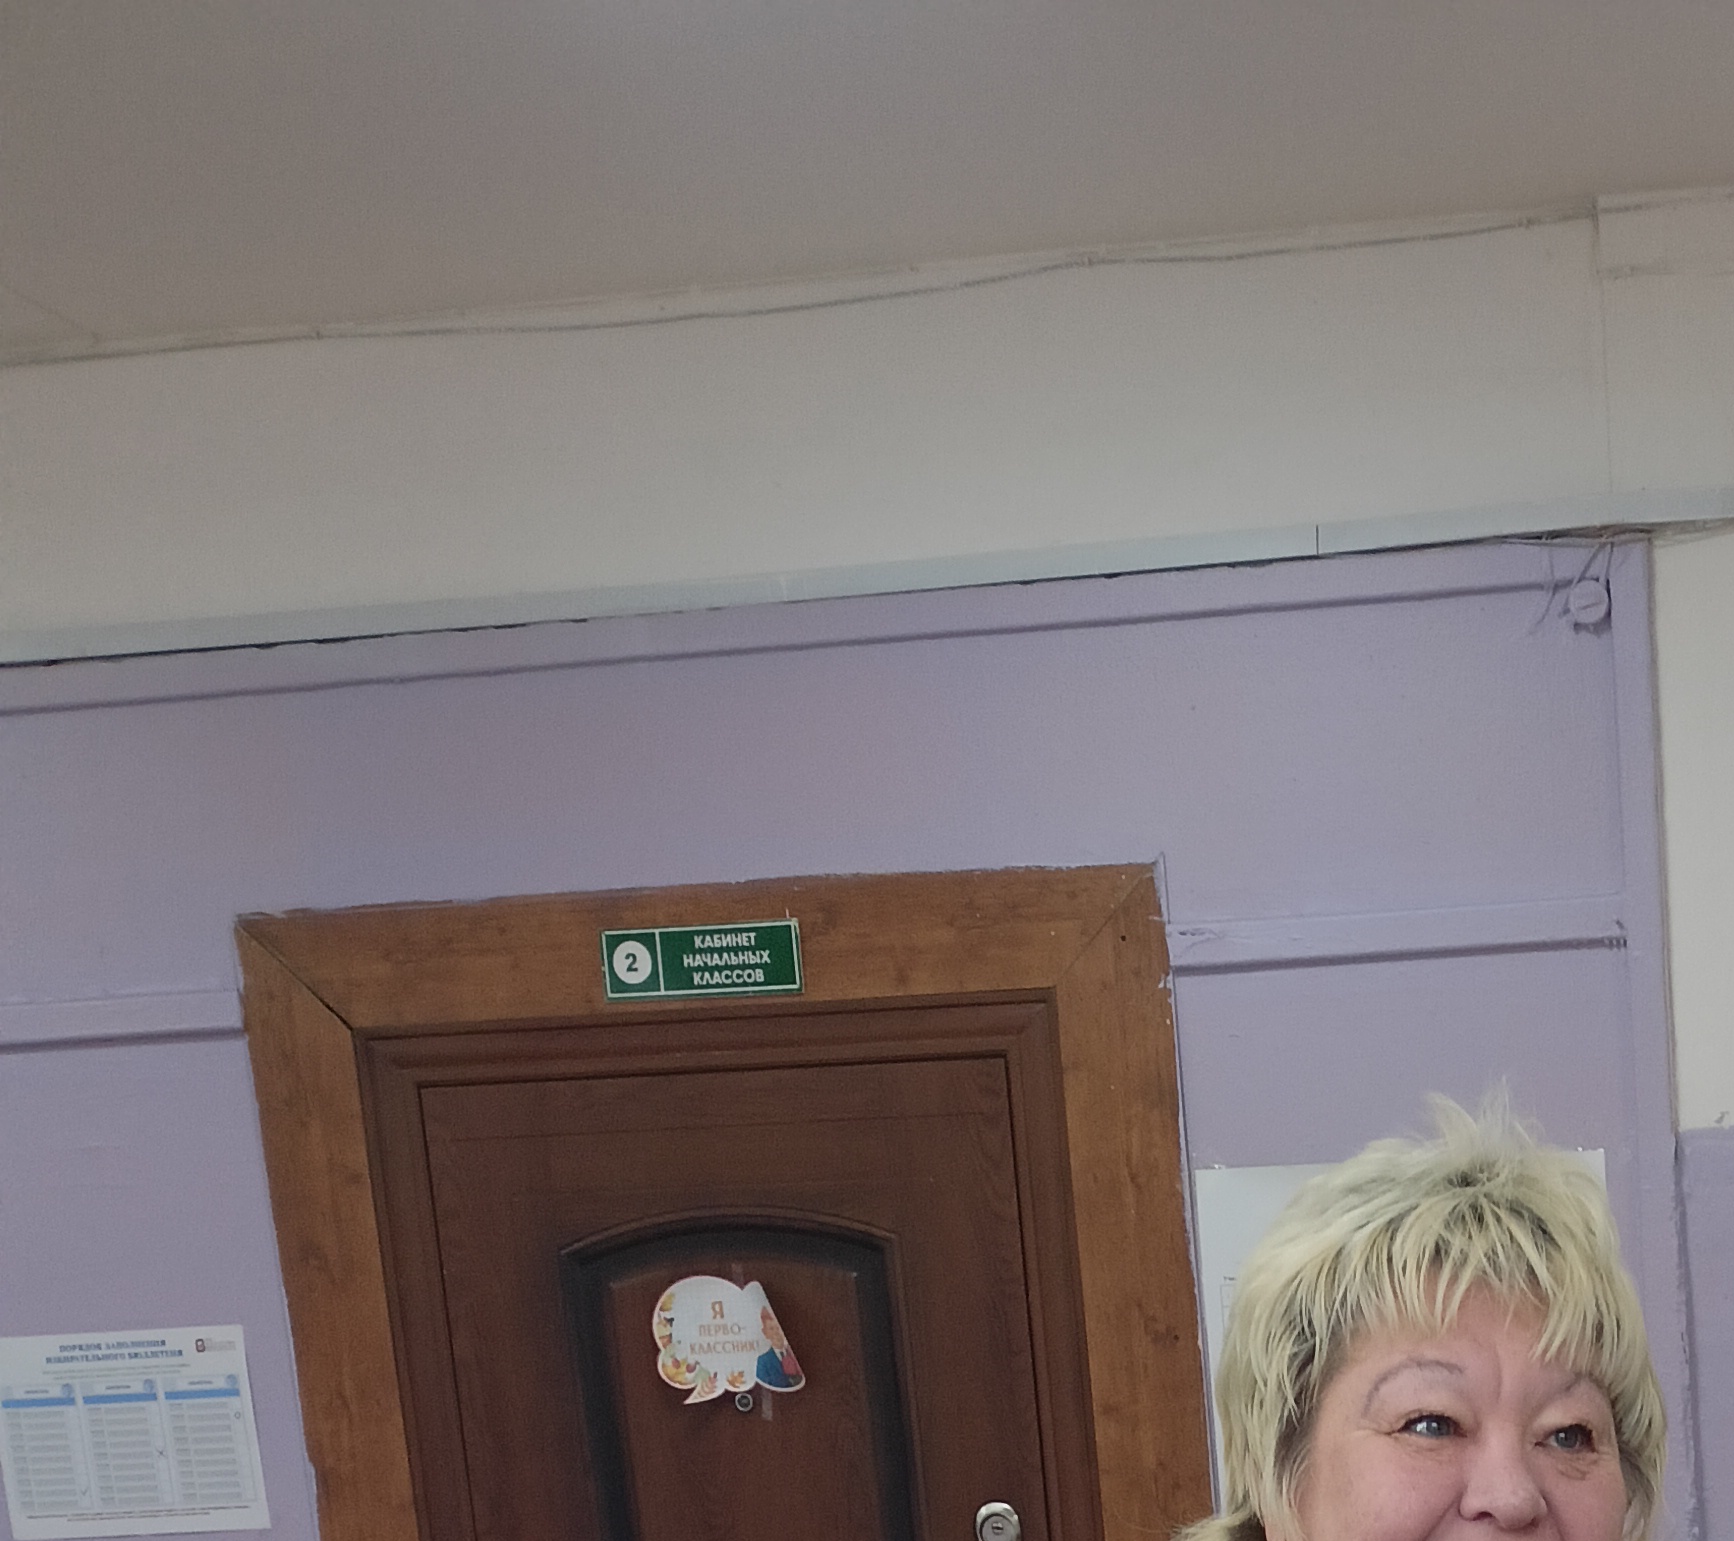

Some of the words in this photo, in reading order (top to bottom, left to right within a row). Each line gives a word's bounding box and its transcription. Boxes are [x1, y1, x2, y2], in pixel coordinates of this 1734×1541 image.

[694, 932, 757, 949] КАБИНЕТ
[624, 953, 638, 972] 2
[683, 950, 771, 968] НАЧАЛЬНЫХ
[693, 969, 765, 986] КЛАССОВ
[711, 1301, 724, 1319] Я
